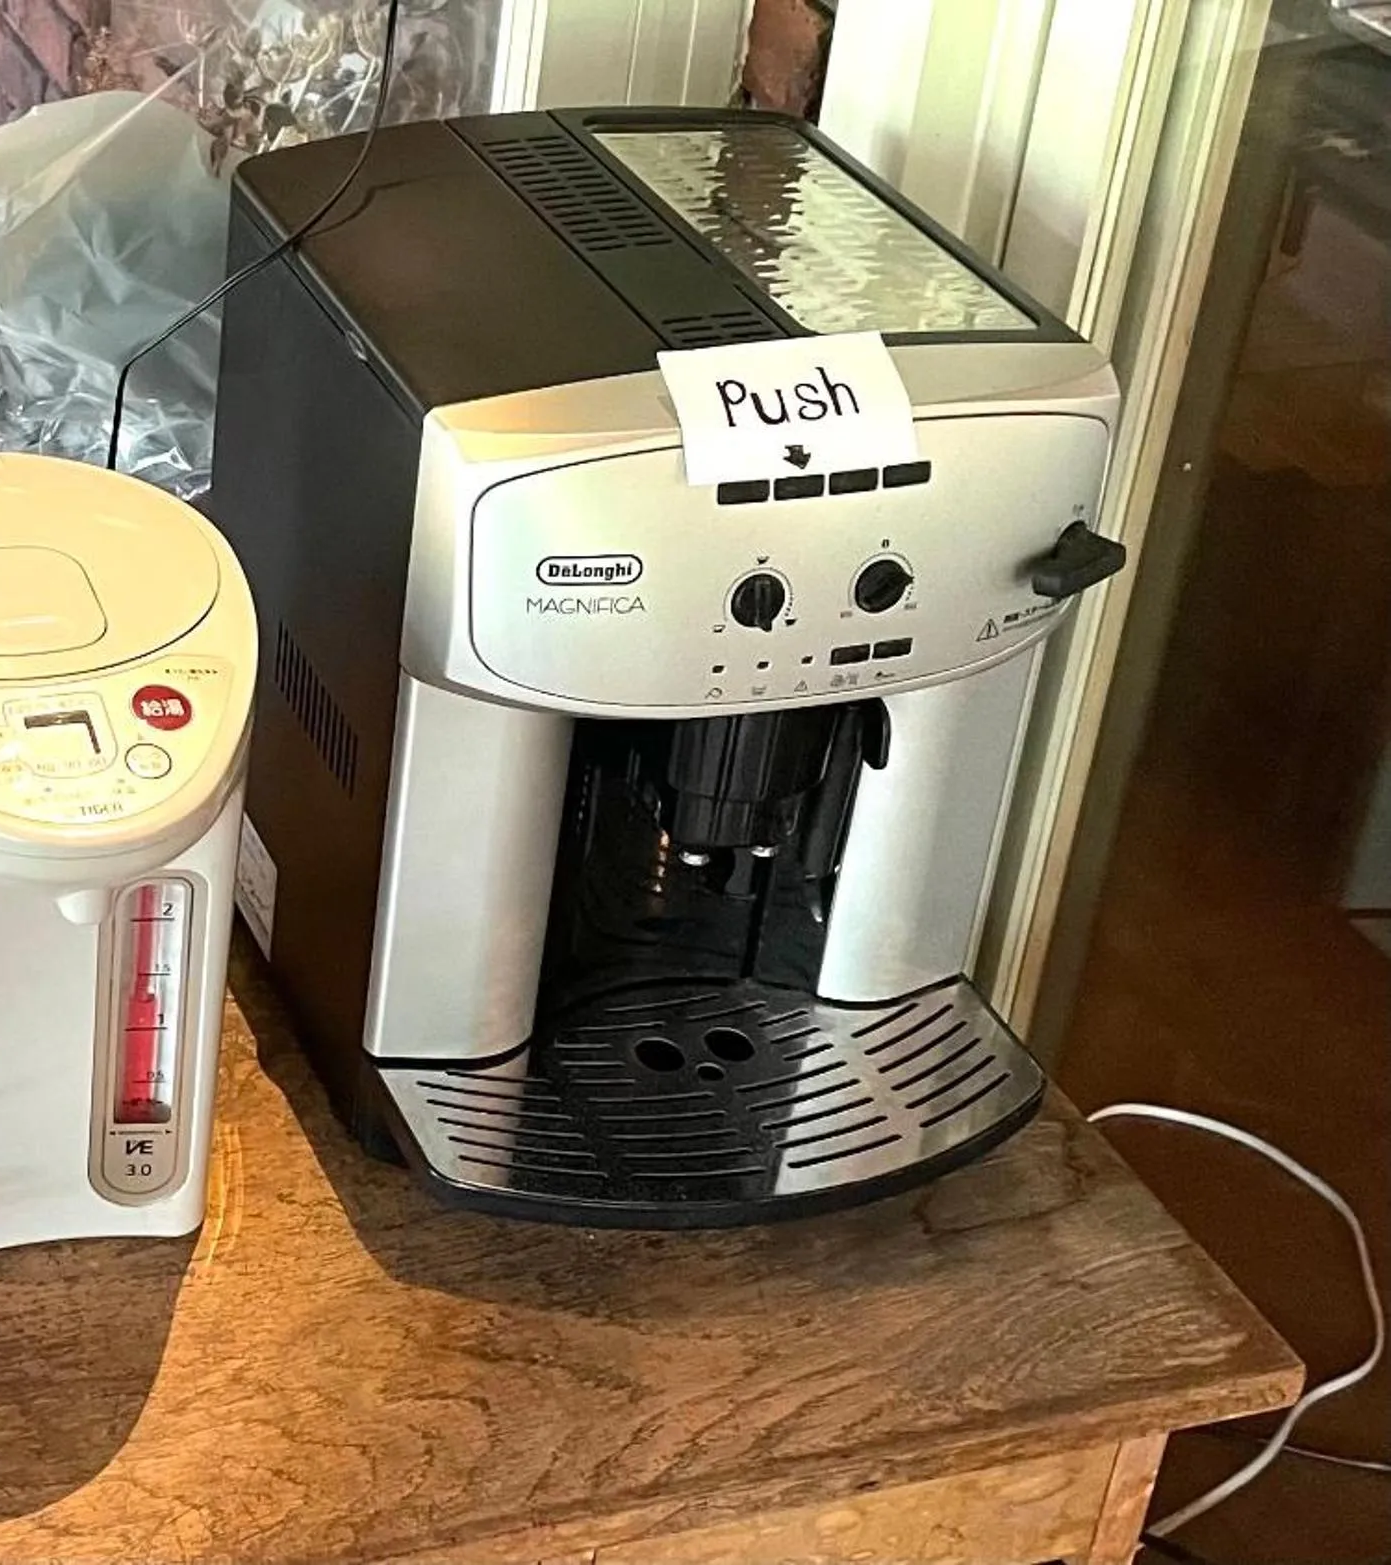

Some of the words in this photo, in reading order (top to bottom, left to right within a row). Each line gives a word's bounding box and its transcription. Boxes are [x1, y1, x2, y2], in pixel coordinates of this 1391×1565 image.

[716, 367, 859, 427] Push
[526, 596, 646, 615] MAGNIFICA
[140, 698, 185, 717] 給湯
[162, 902, 174, 916] 2
[157, 1012, 165, 1025] 1
[125, 1163, 152, 1177] 3.0
